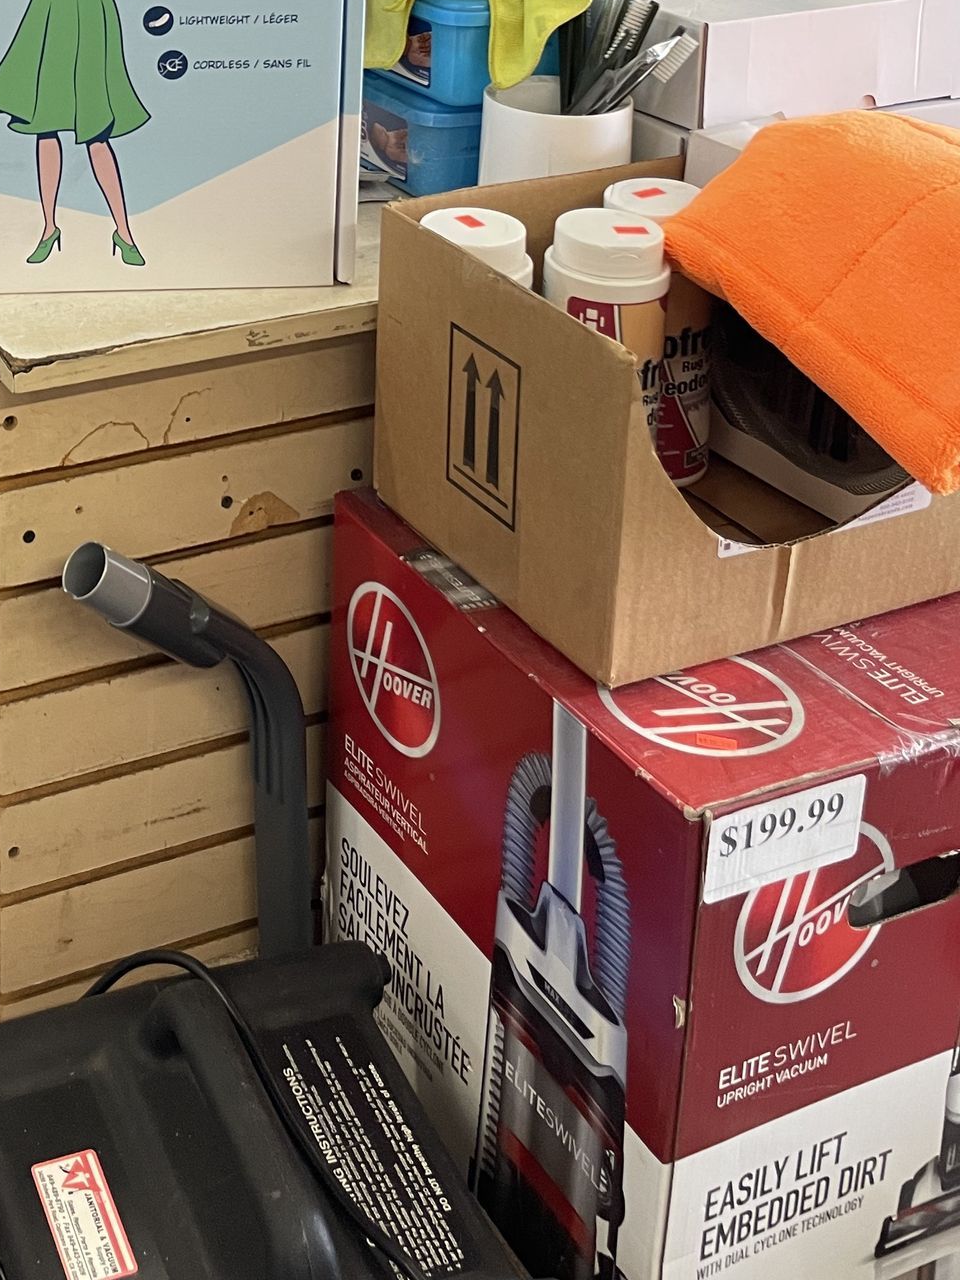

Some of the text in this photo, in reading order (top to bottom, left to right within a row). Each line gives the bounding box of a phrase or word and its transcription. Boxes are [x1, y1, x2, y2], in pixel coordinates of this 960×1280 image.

[179, 12, 299, 26] LIGHTWEIGHT LÉGER
[193, 58, 312, 70] CORDLESS SANS FIL
[886, 658, 945, 698] UPRIGHT
[344, 760, 429, 856] ASPIRATEUR VERTICAL
[719, 791, 845, 859] $199.99
[341, 837, 410, 937] SOULEVEZ
[340, 868, 423, 979] FACILEMENT
[426, 972, 445, 1020] LA
[390, 971, 472, 1086] INCRUSTÉE
[379, 1087, 390, 1099] of
[716, 1053, 828, 1109] UPRIGHT VACUUM
[280, 1065, 338, 1165] INSTRUCTIONS
[399, 1122, 415, 1143] high
[410, 1141, 432, 1176] breathe
[426, 1174, 443, 1197] NOT
[704, 1131, 848, 1223] EASILY LIFT
[62, 1220, 73, 1234] Fax
[438, 1195, 452, 1212] DO
[700, 1148, 893, 1262] EMBEDDED DIRT
[82, 1191, 105, 1234] JANITORIAL
[101, 1242, 119, 1274] VACUUM
[94, 1245, 107, 1266] Supply
[696, 1194, 865, 1280] WITH DUAL CYCLONE TECHNOLOGY
